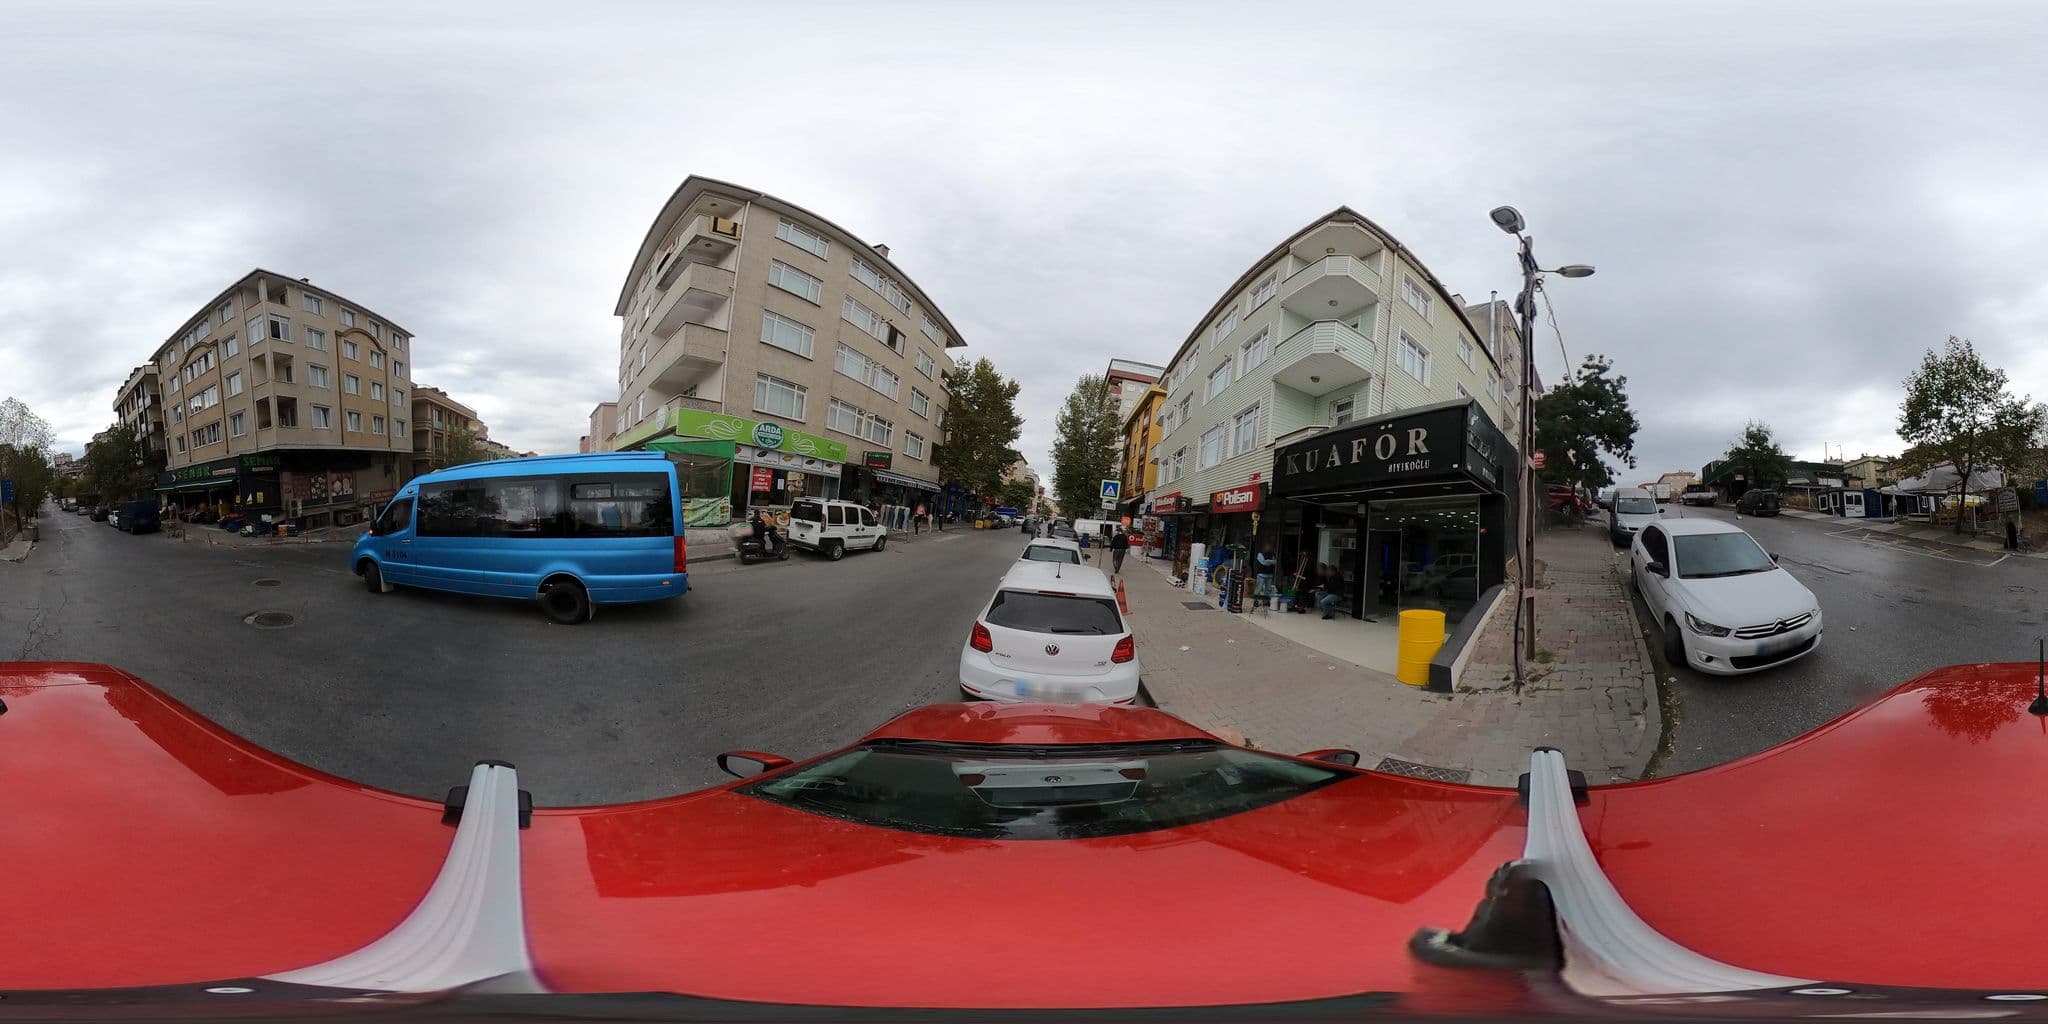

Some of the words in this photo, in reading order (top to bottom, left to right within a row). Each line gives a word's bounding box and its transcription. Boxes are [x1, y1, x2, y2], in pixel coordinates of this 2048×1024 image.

[758, 424, 781, 435] ARDA
[1285, 423, 1431, 476] KUAFÖR
[1223, 489, 1253, 506] Polisan
